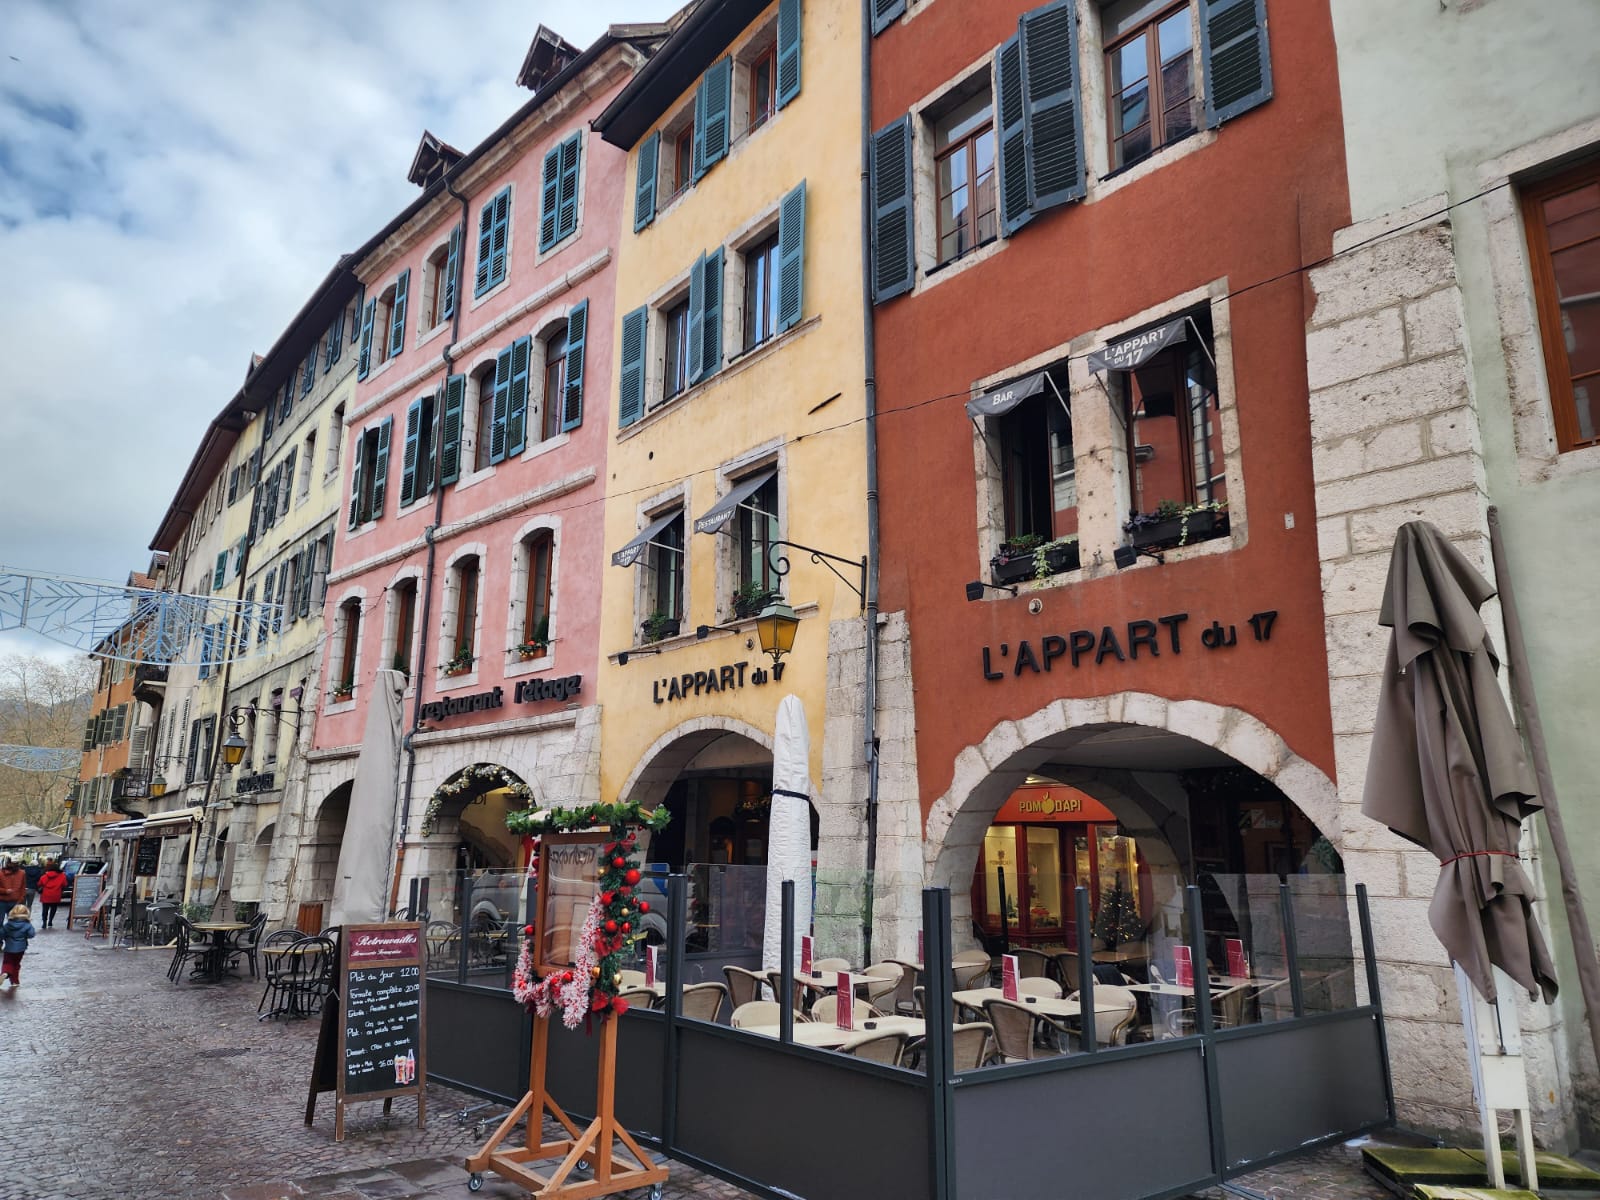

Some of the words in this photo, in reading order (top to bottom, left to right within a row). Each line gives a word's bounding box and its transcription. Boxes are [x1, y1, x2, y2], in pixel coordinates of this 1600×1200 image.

[1104, 327, 1167, 361] L'APPART
[1114, 354, 1124, 364] DU
[1125, 348, 1144, 366] 17
[992, 390, 1014, 405] BAR
[982, 613, 1188, 680] L'APPART
[1201, 620, 1237, 651] du
[1248, 610, 1278, 641] 17
[653, 661, 748, 704] L'APPART
[751, 667, 768, 685] du
[771, 662, 786, 681] 17
[419, 686, 504, 721] restaurant
[356, 933, 417, 946] Retrouvailles
[350, 971, 365, 982] Plat
